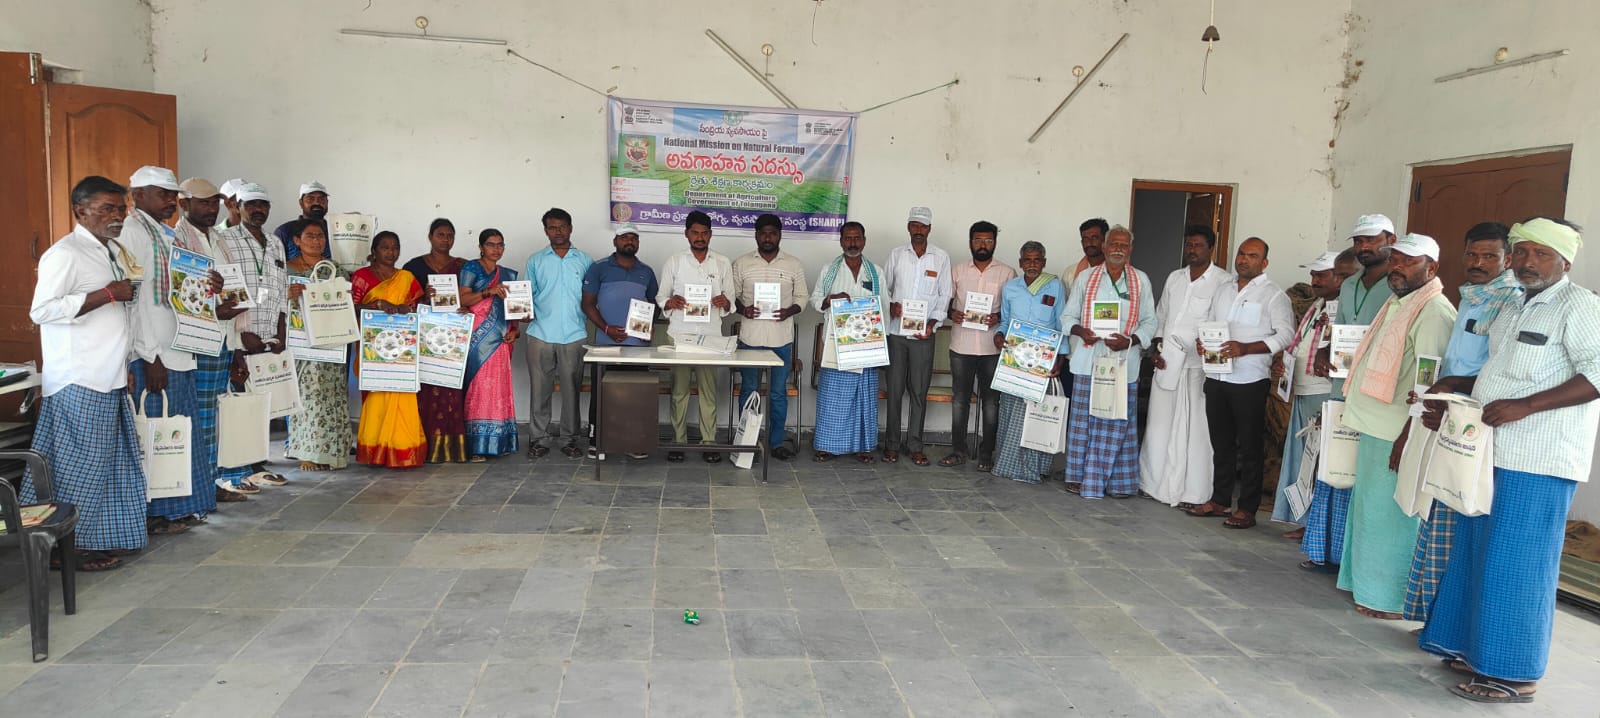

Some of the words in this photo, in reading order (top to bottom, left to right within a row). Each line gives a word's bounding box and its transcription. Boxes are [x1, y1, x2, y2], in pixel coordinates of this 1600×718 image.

[663, 136, 698, 147] National
[699, 139, 731, 151] Mission
[731, 141, 742, 151] on
[743, 142, 772, 153] Natural
[773, 144, 806, 155] Farming
[665, 151, 747, 173] అవగాహన
[750, 155, 804, 184] సదస్సు
[690, 176, 709, 188] రైతు
[685, 190, 727, 199] Department
[736, 193, 777, 202] Agriculture
[687, 198, 730, 206] Government
[739, 200, 777, 209] Telangana
[640, 208, 671, 220] గ్రామీణ
